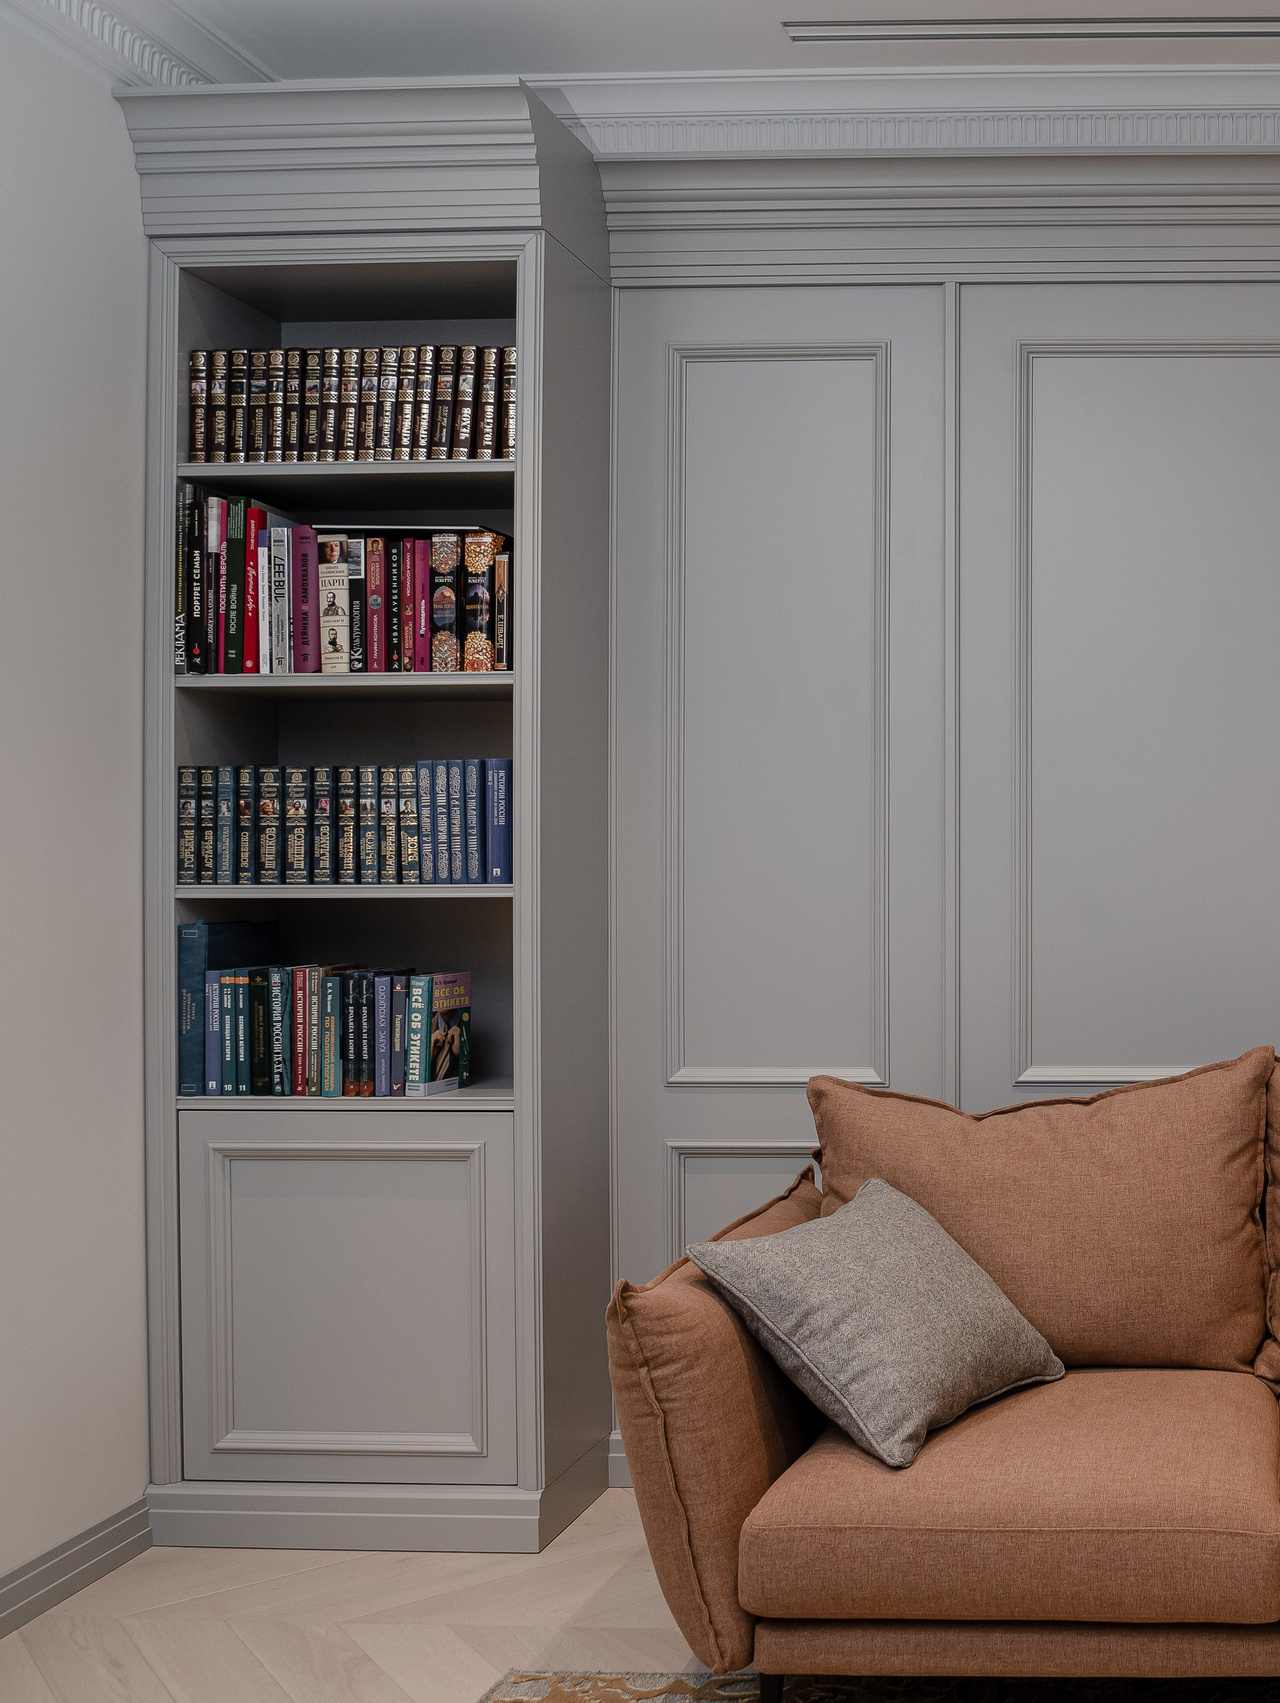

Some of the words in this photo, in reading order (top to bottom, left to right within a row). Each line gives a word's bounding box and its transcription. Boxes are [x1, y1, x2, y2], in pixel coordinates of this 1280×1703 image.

[215, 410, 226, 446] ЛЕСКОВ
[272, 406, 282, 447] НЕКРАСОВ
[365, 405, 374, 448] ДОСТОЕВСКИЙ
[381, 401, 392, 448] ДОСТОЕВСКИЙ
[402, 404, 412, 445] ОСТРОВСКИЙ
[419, 404, 429, 446] ОСТРОВСКИЙ
[459, 408, 471, 440] ЧЕХОВ
[483, 405, 494, 446] ТОЛСТОЙ
[274, 556, 285, 578] LEE
[321, 579, 345, 587] ЦАРИ
[175, 613, 185, 665] РЕКЛАМА
[184, 829, 194, 868] ГОРЬКИЙ
[205, 830, 213, 868] АСТАФЬЕВ
[241, 831, 249, 868] ЗОЩЕНКО
[265, 827, 276, 869] ШИШКОВ
[294, 827, 305, 869] ШИШКОВ
[320, 826, 330, 868] ШАЛАМОВ
[344, 825, 354, 869] ЦВЕТАЕВА
[386, 824, 396, 871] ПАСТЕРНАК
[408, 835, 418, 861] БЛОК
[272, 987, 281, 1021] ИСТОРИЯ
[412, 988, 424, 1008] ВСЁ
[434, 996, 470, 1009] ЭТИКЕТЕ
[454, 986, 465, 995] ОБ
[273, 1022, 282, 1052] РОССИИ
[325, 1016, 330, 1028] ПО
[411, 1012, 421, 1028] ОБ
[409, 1034, 420, 1081] ЭТИКЕТЕ
